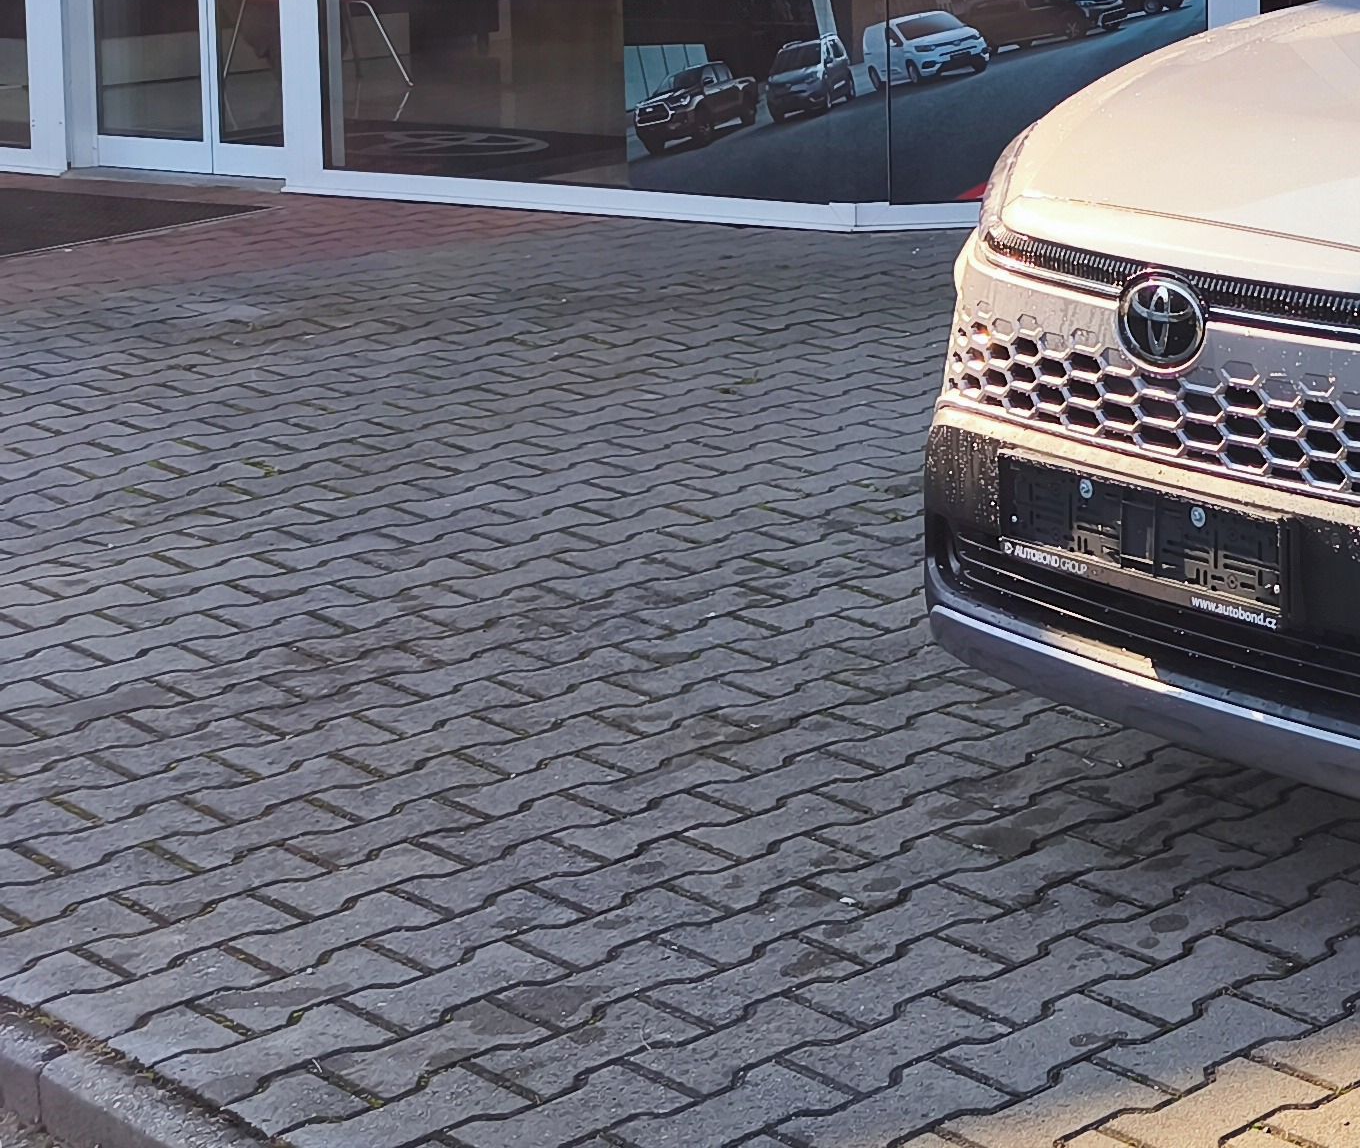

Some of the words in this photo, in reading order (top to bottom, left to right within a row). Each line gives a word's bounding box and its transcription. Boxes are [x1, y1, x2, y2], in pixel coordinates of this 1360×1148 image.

[1014, 545, 1060, 569] AUTOBOND
[1060, 556, 1088, 575] GROUP
[1191, 596, 1277, 630] www.autobond.cz
